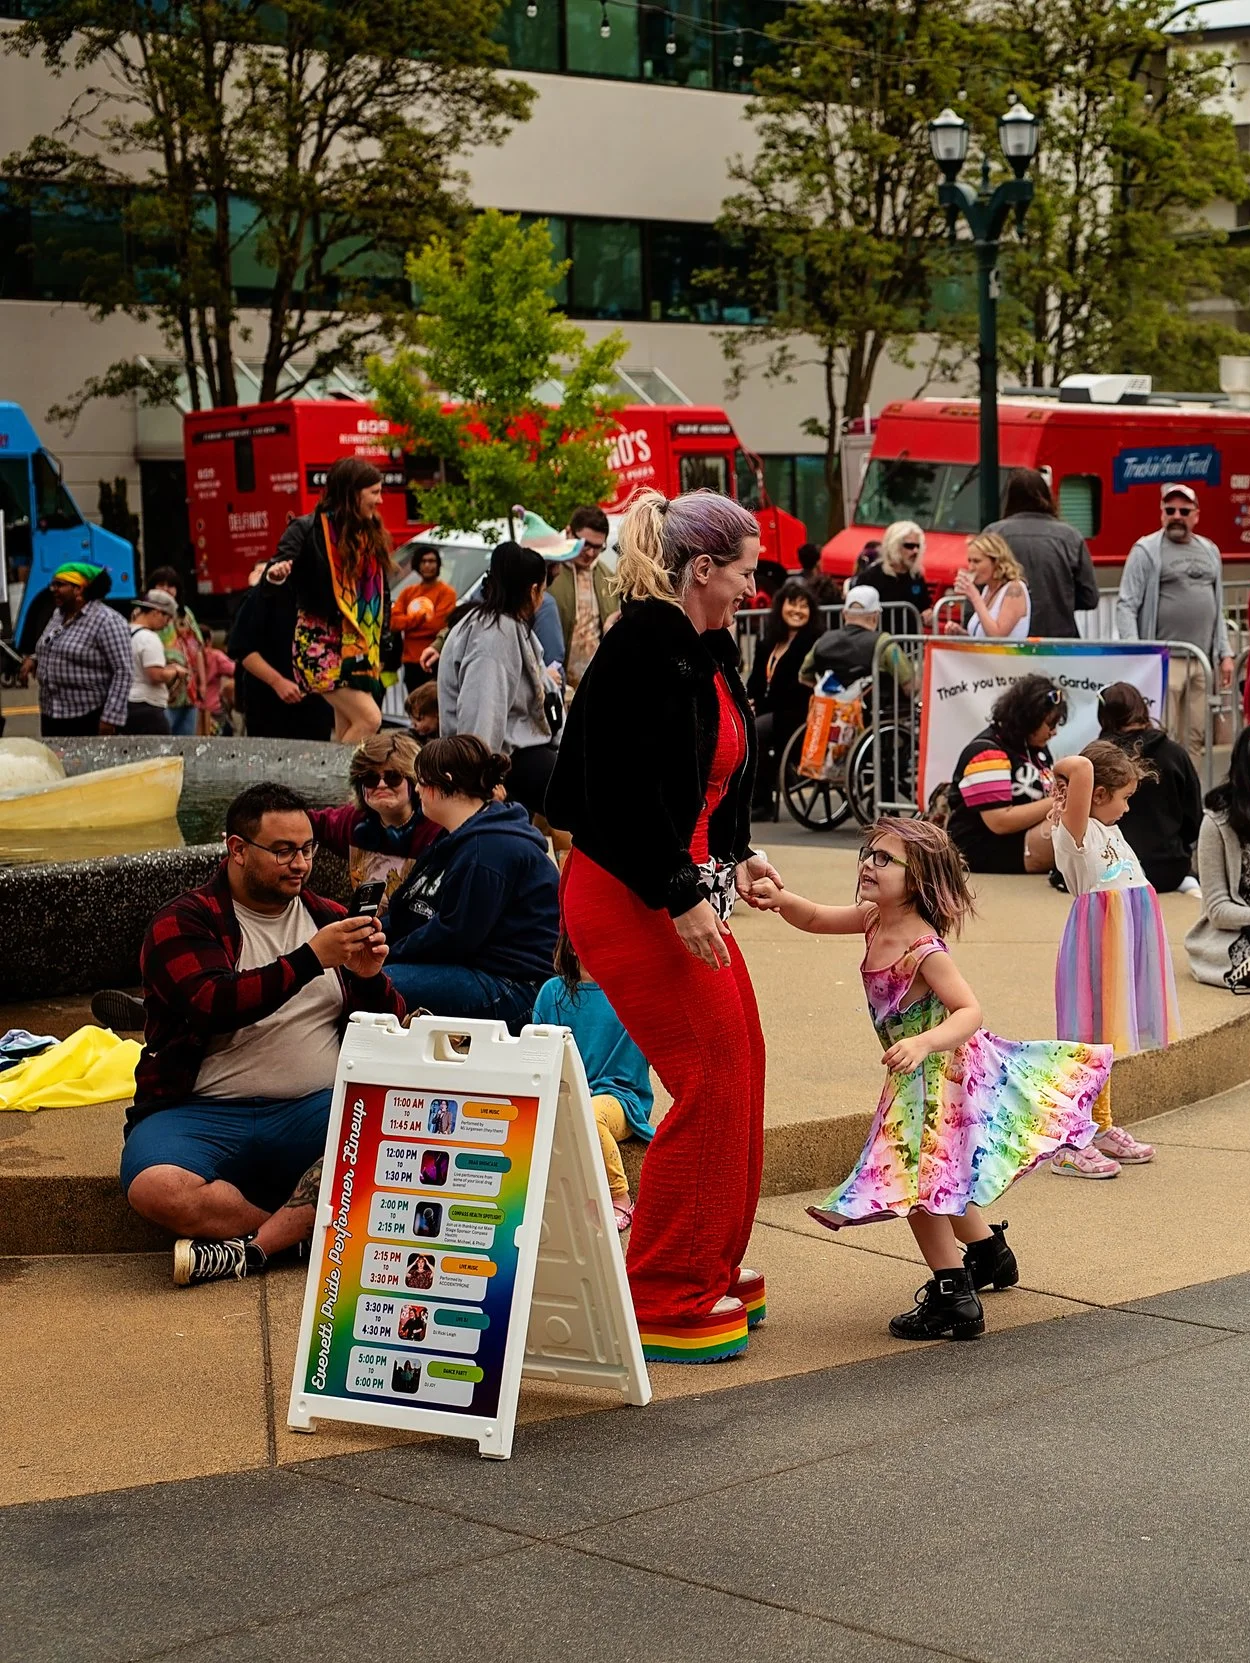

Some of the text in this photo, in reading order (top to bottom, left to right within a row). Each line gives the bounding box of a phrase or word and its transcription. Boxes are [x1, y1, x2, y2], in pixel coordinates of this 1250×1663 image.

[936, 681, 968, 700] Thank
[973, 676, 993, 695] you
[995, 674, 1007, 687] to
[393, 1097, 424, 1108] 11:00 AM
[390, 1120, 421, 1131] 11:45 AM
[386, 1148, 417, 1160] 12:00 PM
[385, 1171, 412, 1182] 1:30 PM
[380, 1199, 408, 1211] 2:00 PM
[378, 1222, 405, 1233] 2:15 PM
[312, 1098, 367, 1390] Everett Pride Performer Lineup
[374, 1250, 401, 1262] 2:15 PM
[370, 1273, 398, 1285] 3:30 PM
[365, 1302, 394, 1314] 3:30 PM
[362, 1324, 391, 1337] 4:30 PM
[358, 1354, 387, 1366] 5:00 PM
[355, 1377, 384, 1389] 6:00 PM
